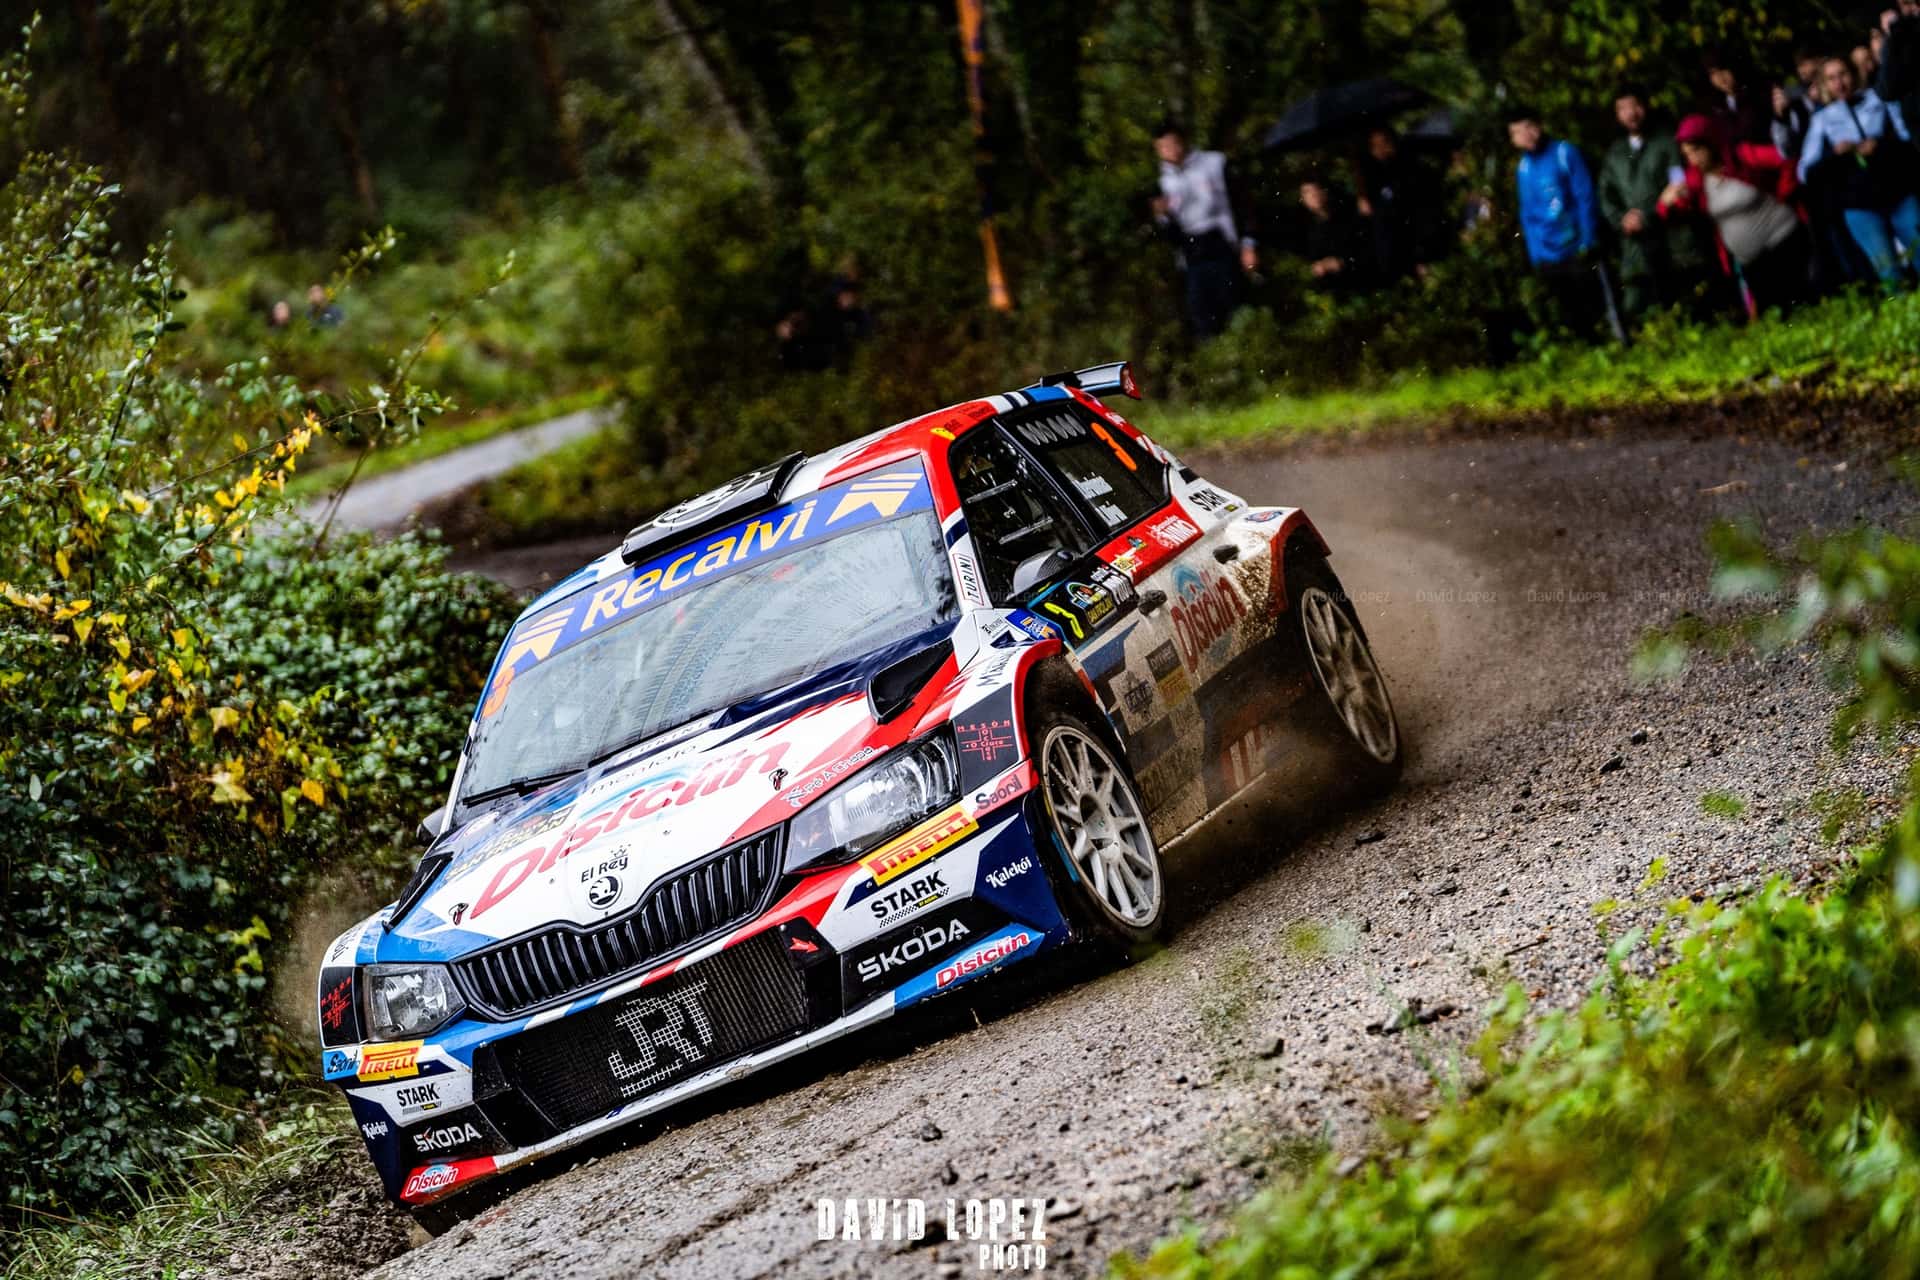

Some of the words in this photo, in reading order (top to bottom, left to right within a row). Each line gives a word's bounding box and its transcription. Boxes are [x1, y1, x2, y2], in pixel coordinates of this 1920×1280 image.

[1090, 422, 1137, 472] 3
[580, 500, 818, 632] Recalvi
[482, 667, 516, 718] 3
[470, 740, 791, 919] Disiclin
[867, 810, 972, 877] PIRELLI
[581, 868, 596, 884] El
[597, 854, 629, 876] Rey
[871, 869, 948, 918] STARK
[936, 931, 1031, 990] Disiclin
[607, 978, 713, 1080] JRT
[359, 1046, 419, 1074] PIRELLI
[397, 1082, 440, 1108] STARK
[406, 1164, 458, 1199] Disiclin
